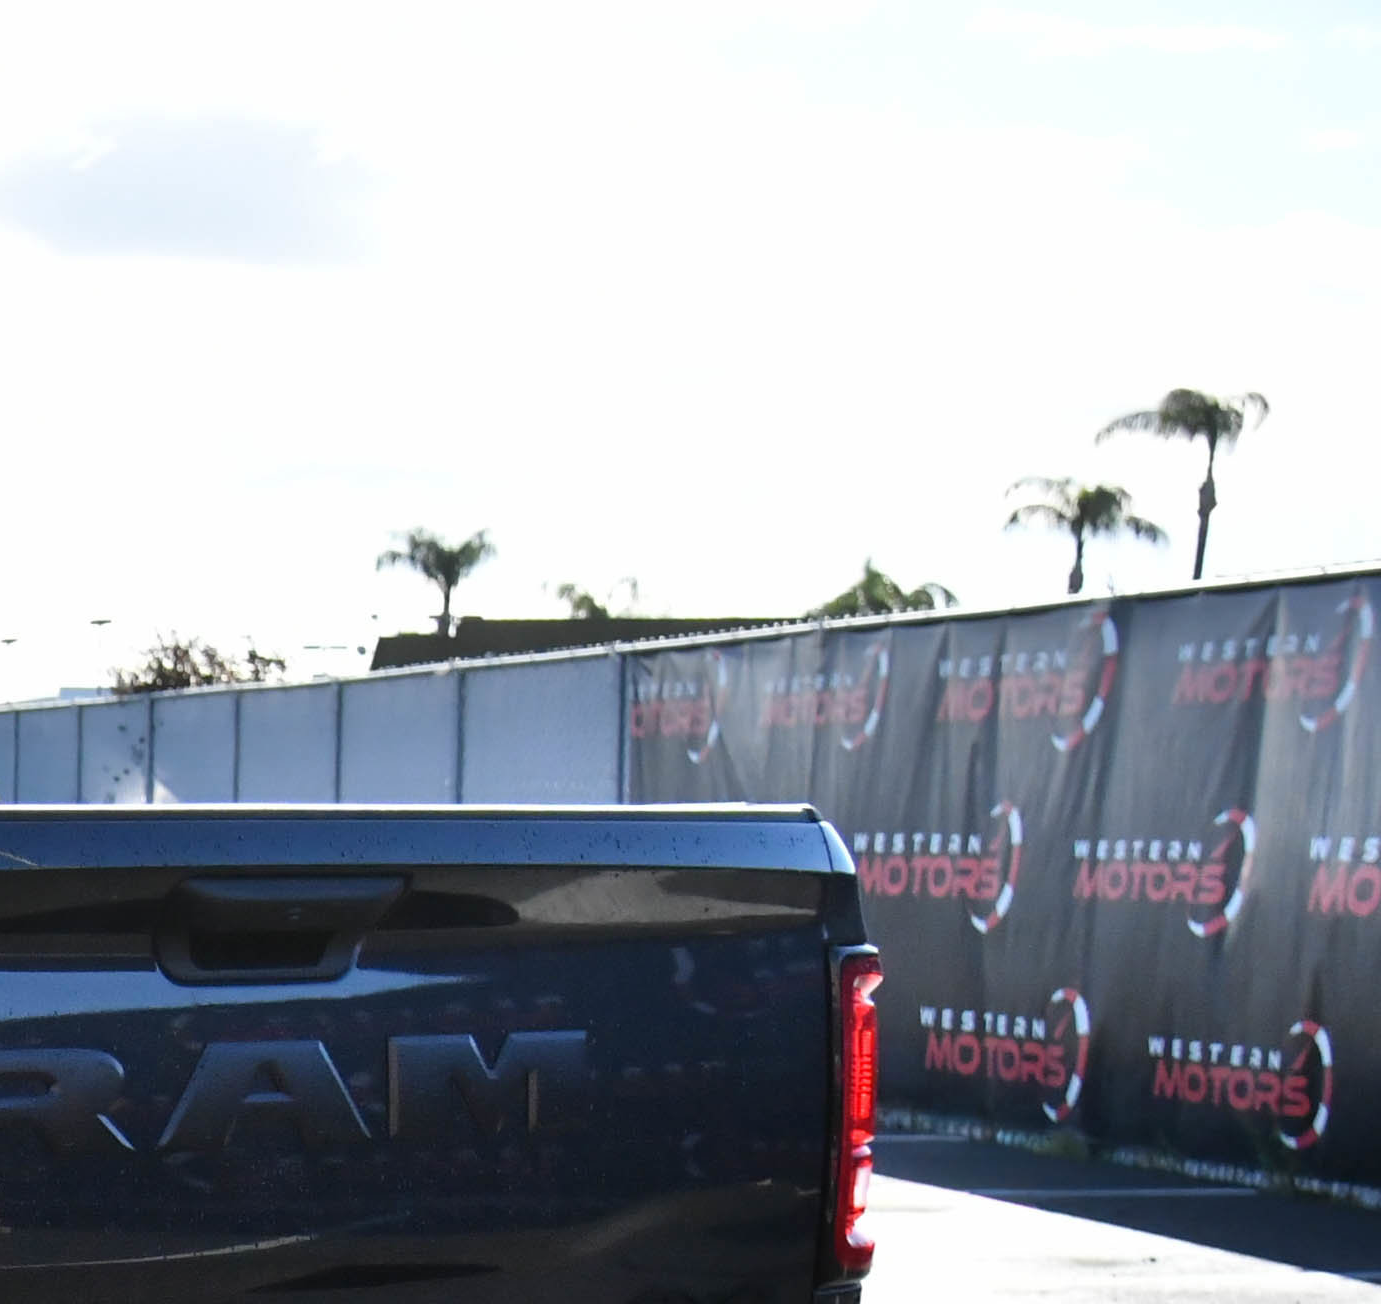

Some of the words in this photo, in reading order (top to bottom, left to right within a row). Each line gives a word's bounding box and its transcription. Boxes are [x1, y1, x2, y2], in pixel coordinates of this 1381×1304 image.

[938, 669, 1087, 722] MOTORS
[1175, 652, 1343, 704] MOTORS
[854, 833, 982, 854] WESTERN
[1074, 840, 1202, 860] WESTERN
[857, 856, 1000, 899] MOTORS
[1073, 860, 1226, 904] MOTORS
[919, 1006, 1045, 1040] WESTERN
[925, 1030, 1065, 1088] MOTORS
[1148, 1037, 1282, 1071] WESTERN
[1154, 1060, 1310, 1117] MOTORS
